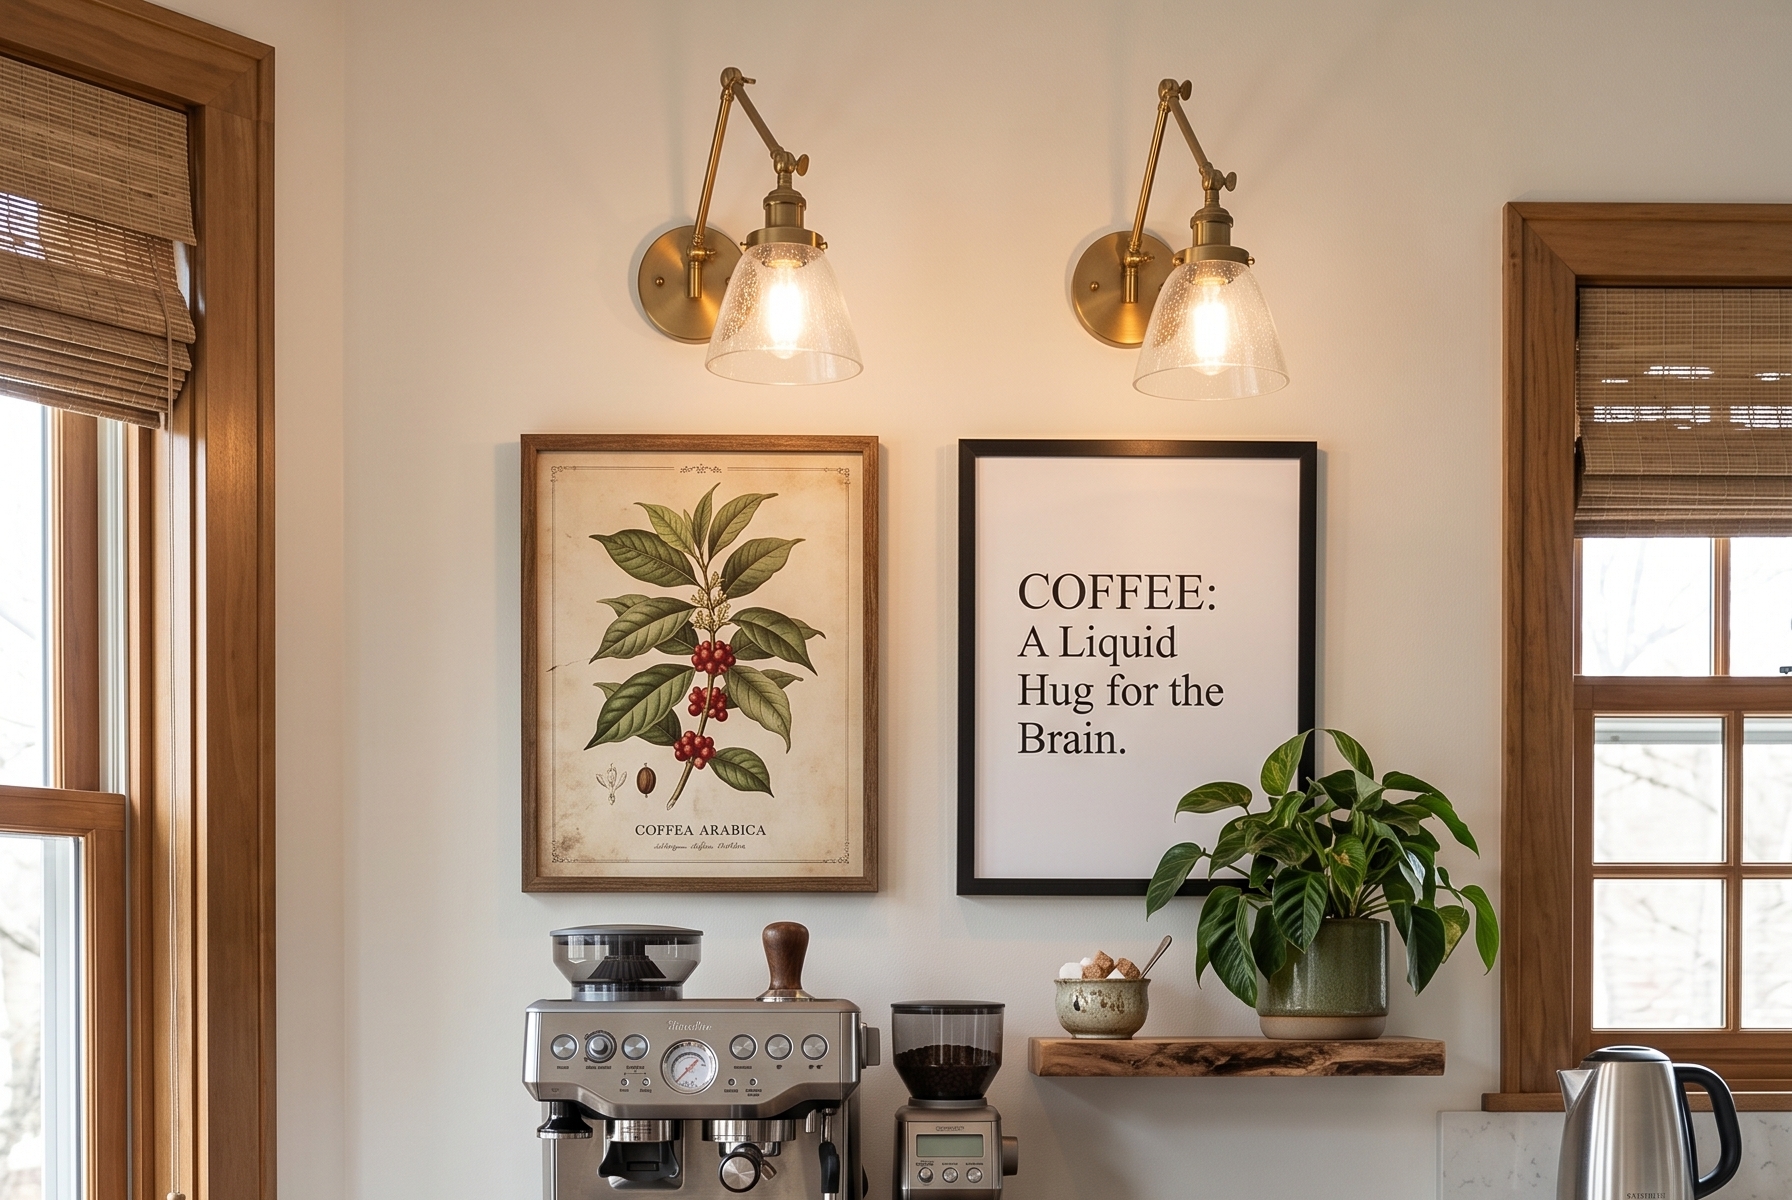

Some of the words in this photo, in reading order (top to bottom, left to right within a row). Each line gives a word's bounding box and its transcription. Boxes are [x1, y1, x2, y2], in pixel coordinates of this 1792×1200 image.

[1018, 573, 1216, 610] COFFEE:
[1017, 625, 1050, 658] A
[1058, 625, 1178, 667] Liquid
[1017, 673, 1094, 715] Hug
[1106, 673, 1159, 706] for
[1168, 673, 1224, 706] the
[1017, 721, 1126, 755] Brain.
[635, 824, 694, 836] COFFEA
[699, 824, 767, 836] ARABICA
